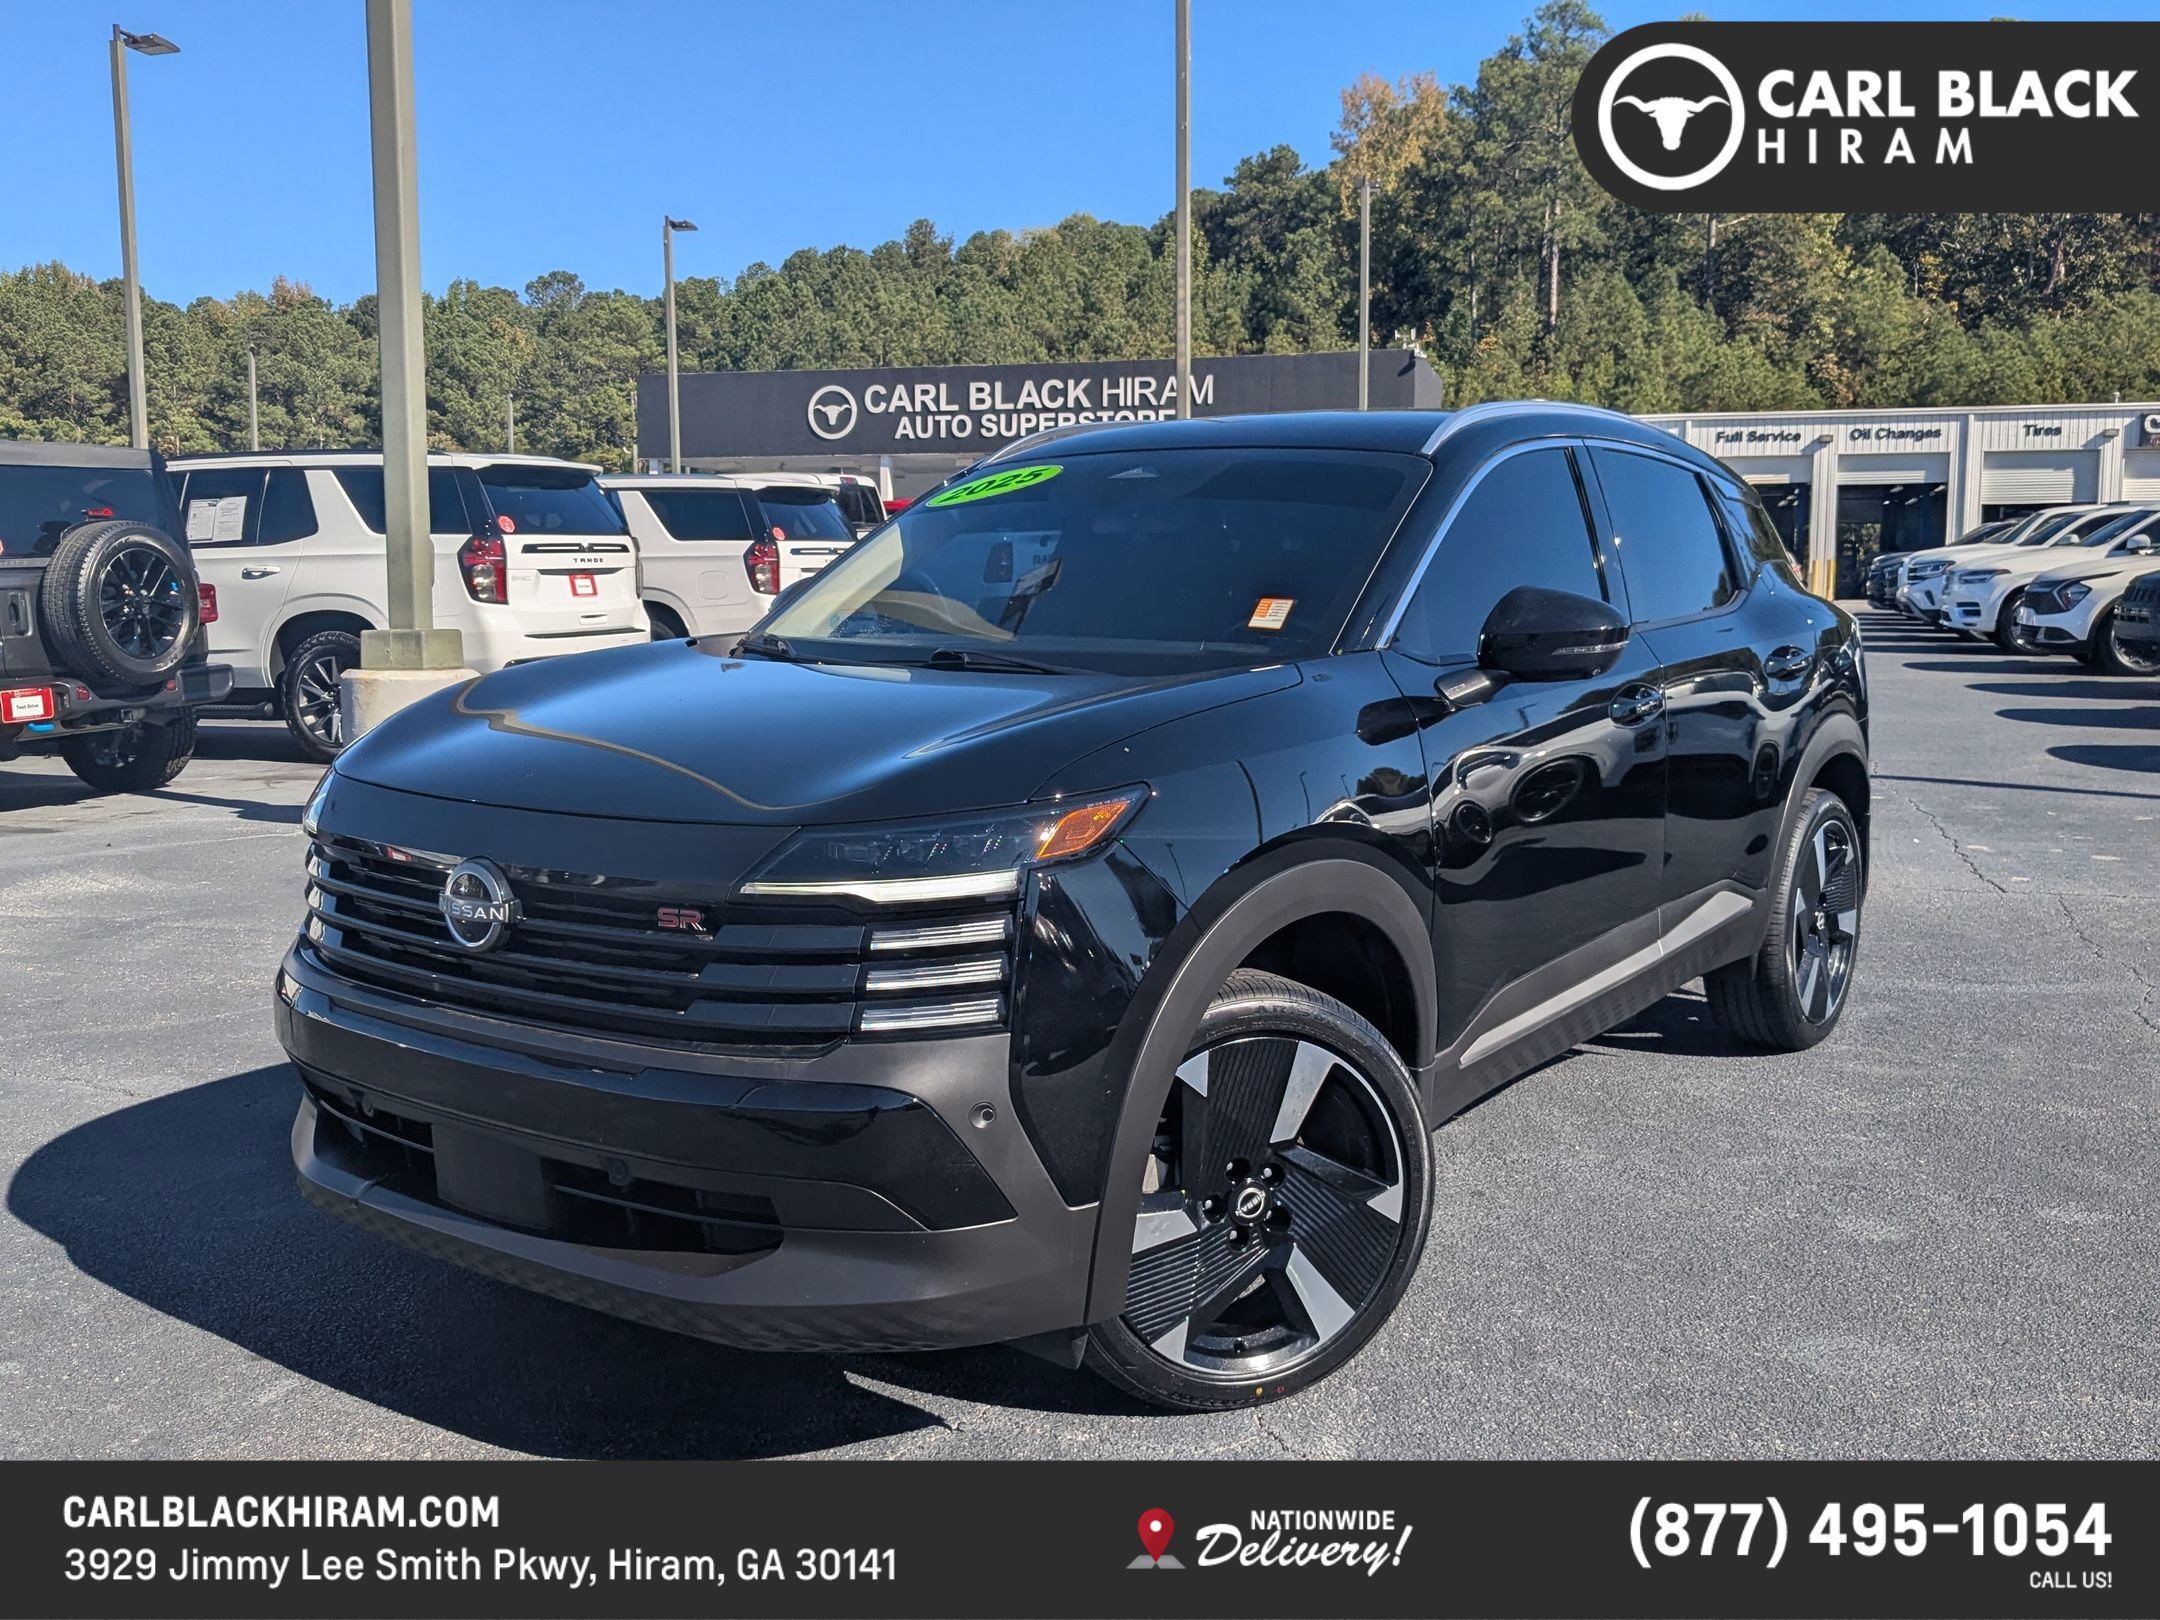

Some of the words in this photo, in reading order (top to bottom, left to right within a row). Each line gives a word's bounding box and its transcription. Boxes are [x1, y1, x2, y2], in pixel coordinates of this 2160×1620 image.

[865, 383, 960, 414] CARL
[969, 378, 1092, 411] BLACK
[894, 413, 973, 440] AUTO
[1716, 431, 1743, 443] Full
[1747, 430, 1801, 442] Service
[1850, 428, 1871, 441] Oil
[1875, 427, 1942, 441] Changes
[2022, 424, 2062, 437] Tires
[937, 468, 1052, 503] 2025
[439, 896, 504, 921] NISSAN
[657, 907, 703, 931] SR
